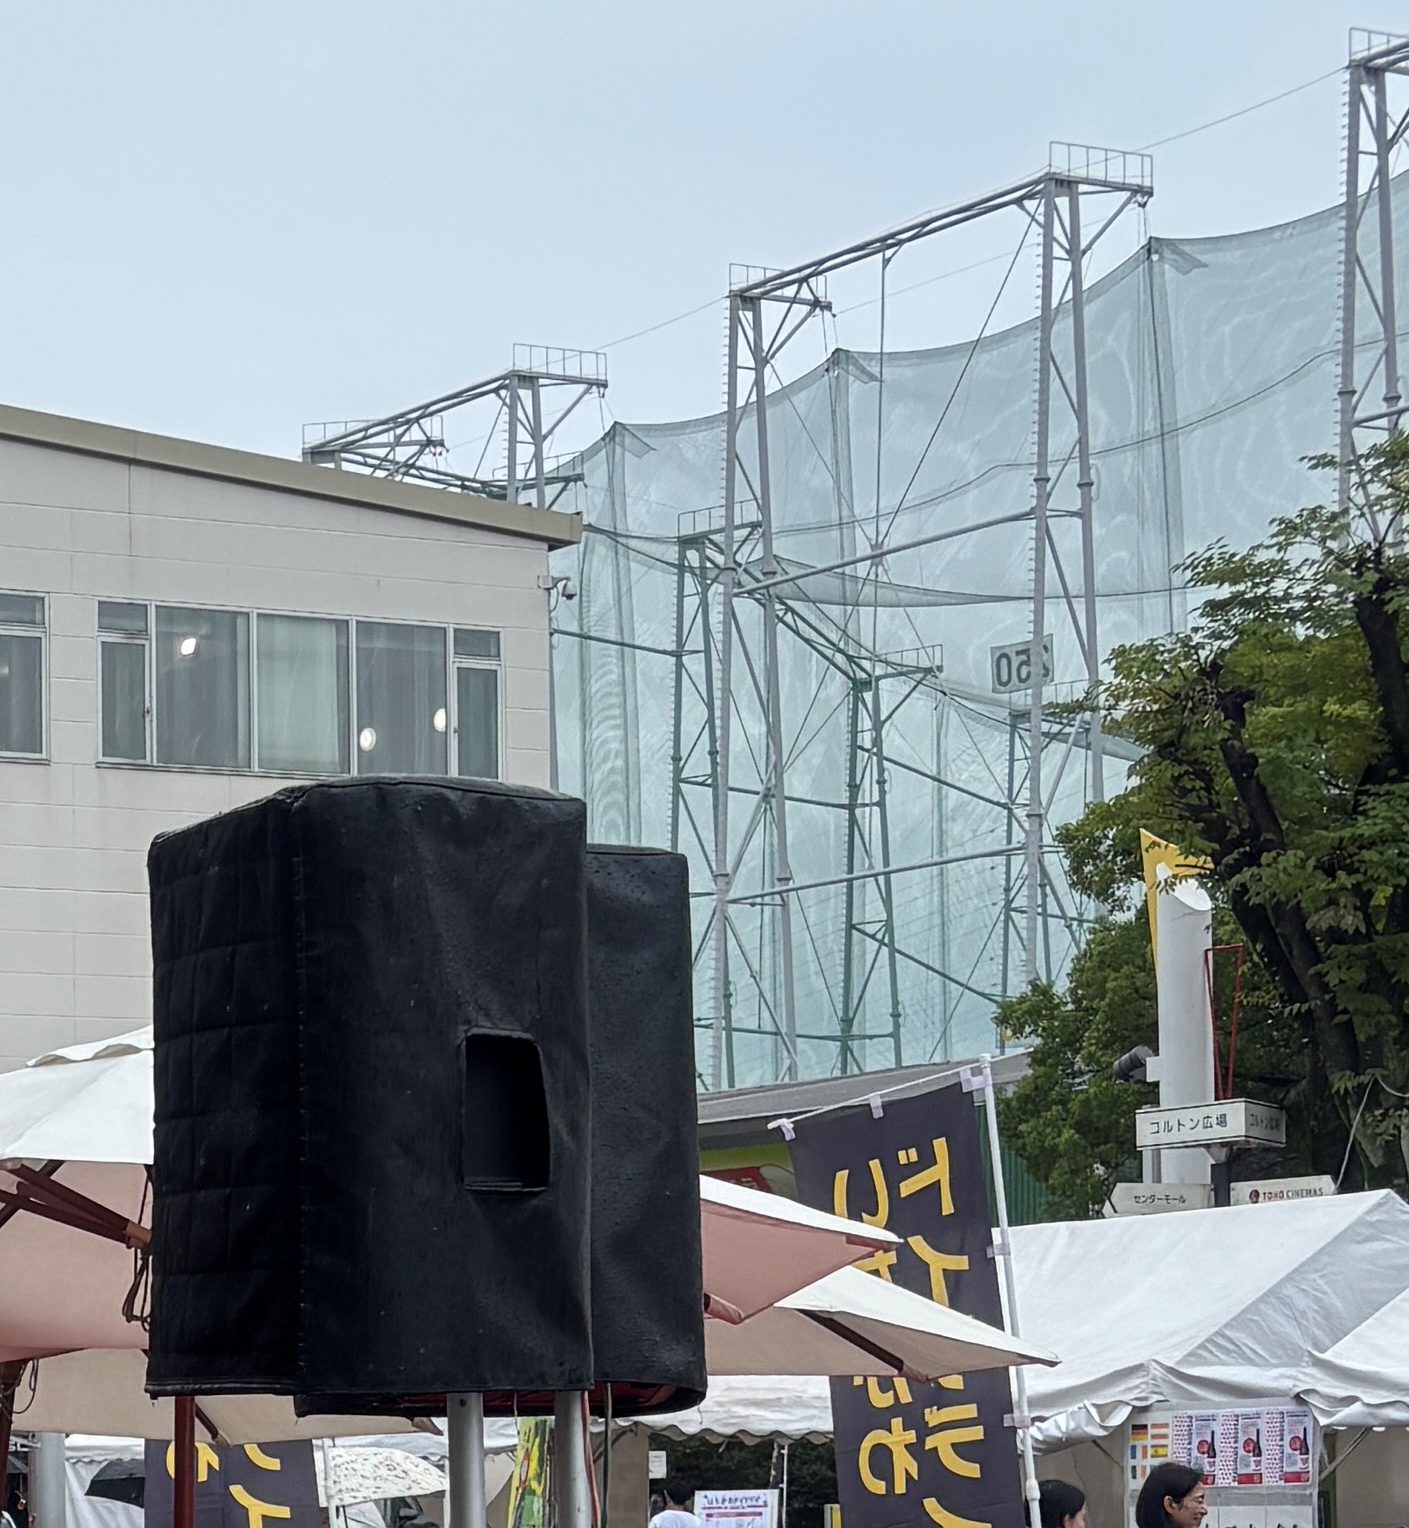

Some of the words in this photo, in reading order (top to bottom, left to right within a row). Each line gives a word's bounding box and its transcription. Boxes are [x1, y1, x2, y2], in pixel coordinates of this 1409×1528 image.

[1149, 1113, 1228, 1135] コルトン広場
